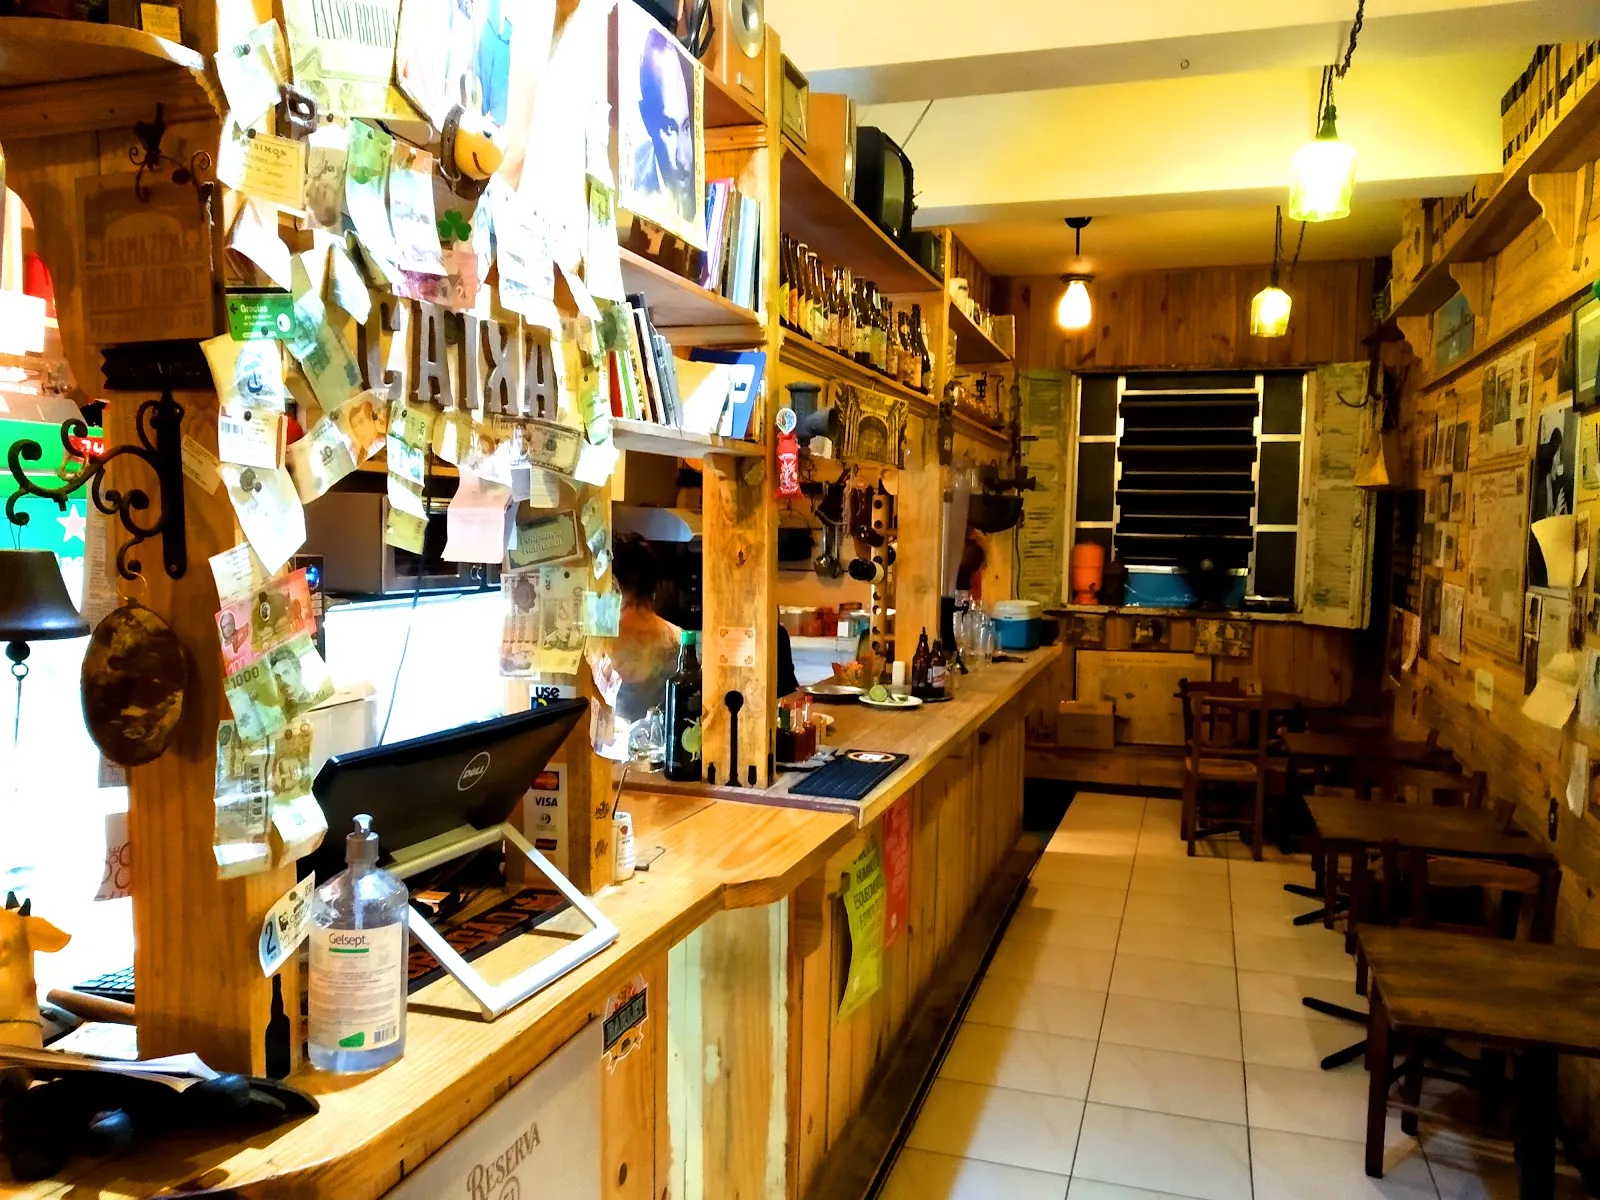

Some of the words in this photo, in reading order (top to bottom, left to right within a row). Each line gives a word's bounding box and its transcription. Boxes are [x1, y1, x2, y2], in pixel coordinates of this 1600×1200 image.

[230, 666, 260, 689] 1000
[535, 686, 561, 699] use
[462, 764, 485, 779] DELL
[535, 796, 559, 807] VISA
[328, 932, 367, 948] Gelsept
[466, 1121, 542, 1200] RESERVA
